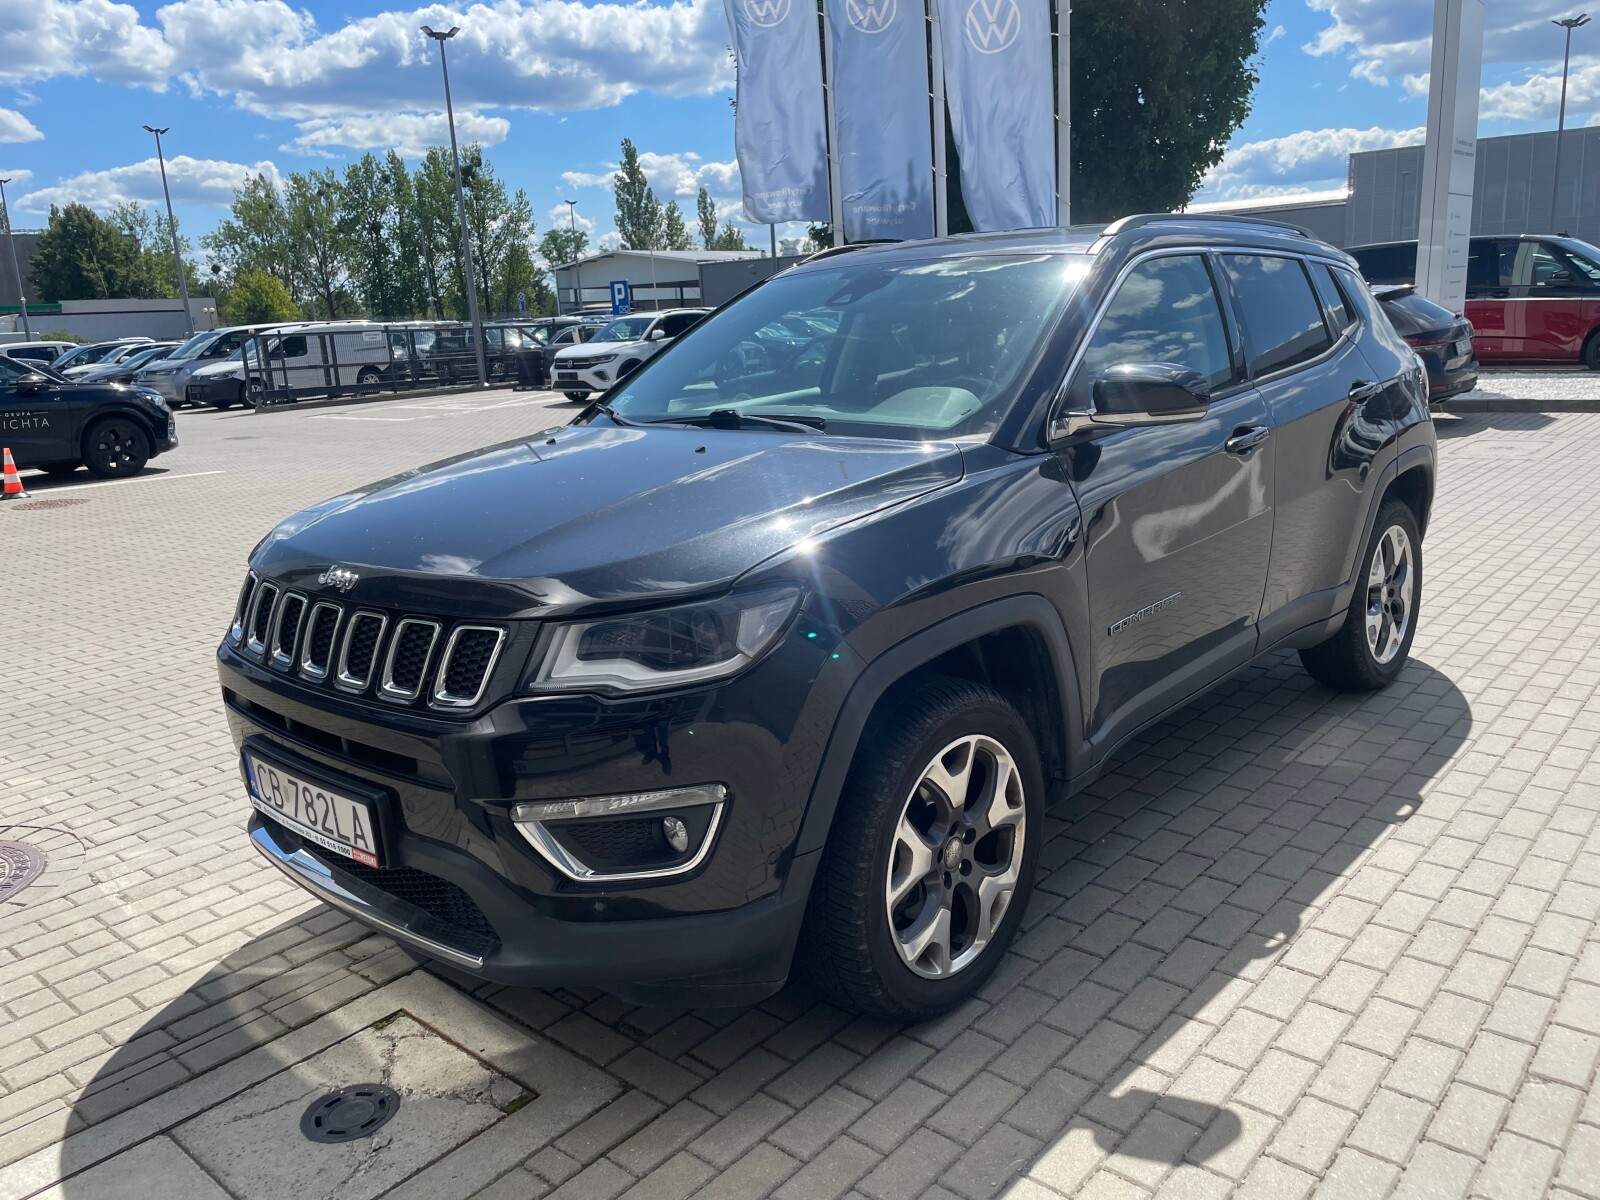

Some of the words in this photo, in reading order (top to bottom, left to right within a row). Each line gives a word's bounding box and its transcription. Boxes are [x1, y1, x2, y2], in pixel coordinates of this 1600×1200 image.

[613, 283, 626, 306] P
[0, 417, 50, 430] ICHTA
[317, 564, 359, 593] Jeep
[257, 764, 284, 809] CB
[287, 779, 369, 850] 782LA
